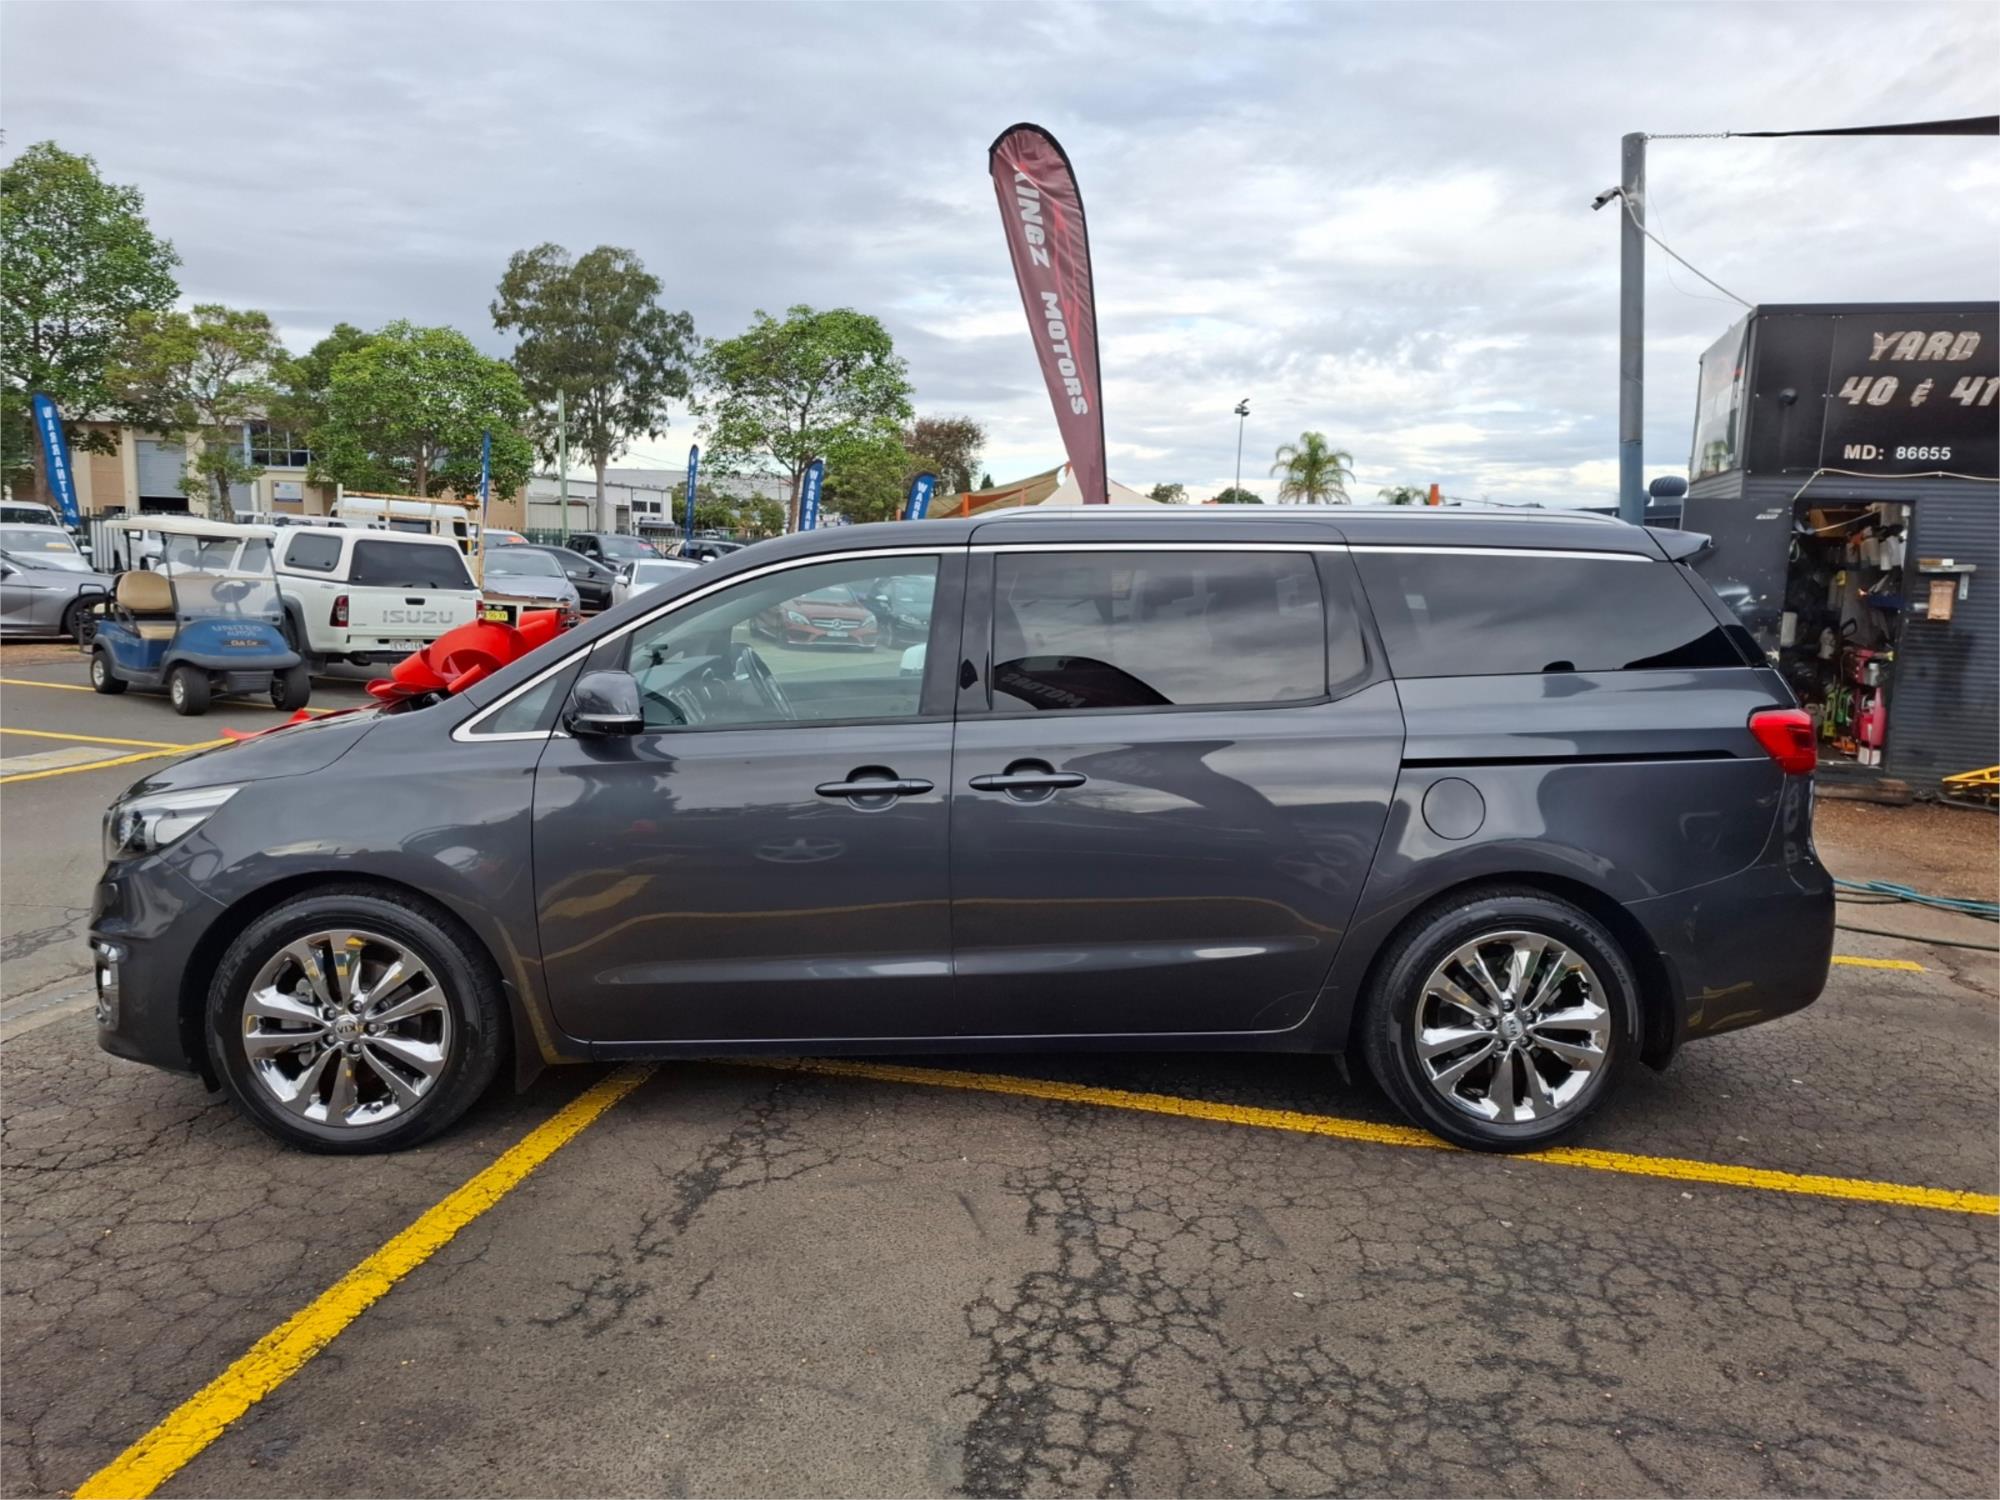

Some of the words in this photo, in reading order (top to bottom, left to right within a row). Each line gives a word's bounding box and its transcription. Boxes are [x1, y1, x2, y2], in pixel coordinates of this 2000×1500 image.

[1041, 291, 1088, 415] MOTORS
[1869, 331, 1981, 361] YARD
[1838, 376, 1899, 406] 40
[42, 406, 69, 504] WARRANTY
[1844, 444, 1885, 460] MD:
[1895, 446, 1951, 460] 86655
[382, 609, 454, 624] ISUZU
